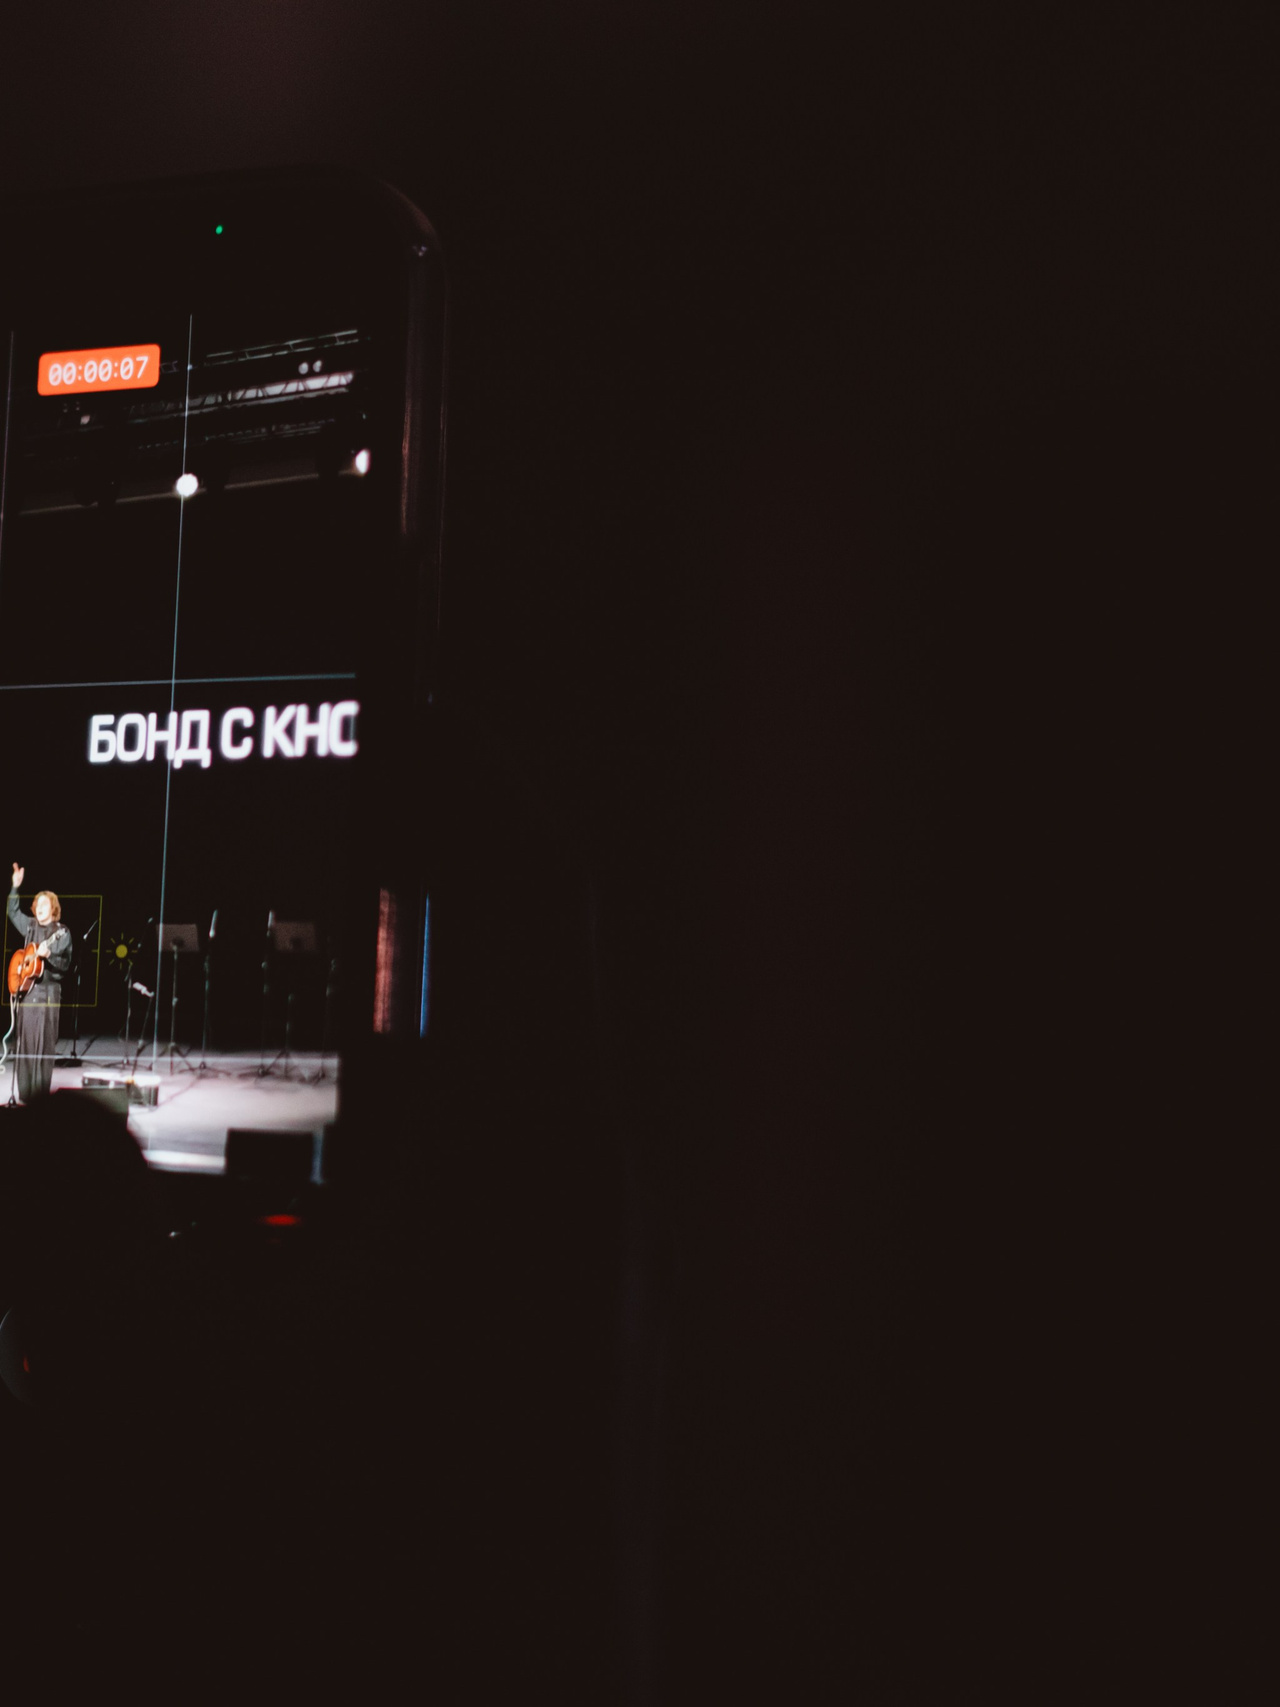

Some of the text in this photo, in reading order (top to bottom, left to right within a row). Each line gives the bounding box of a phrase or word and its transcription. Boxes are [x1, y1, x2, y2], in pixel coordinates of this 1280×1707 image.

[48, 355, 149, 386] 00:00:07
[88, 709, 212, 769] БОНД
[220, 706, 254, 760] С
